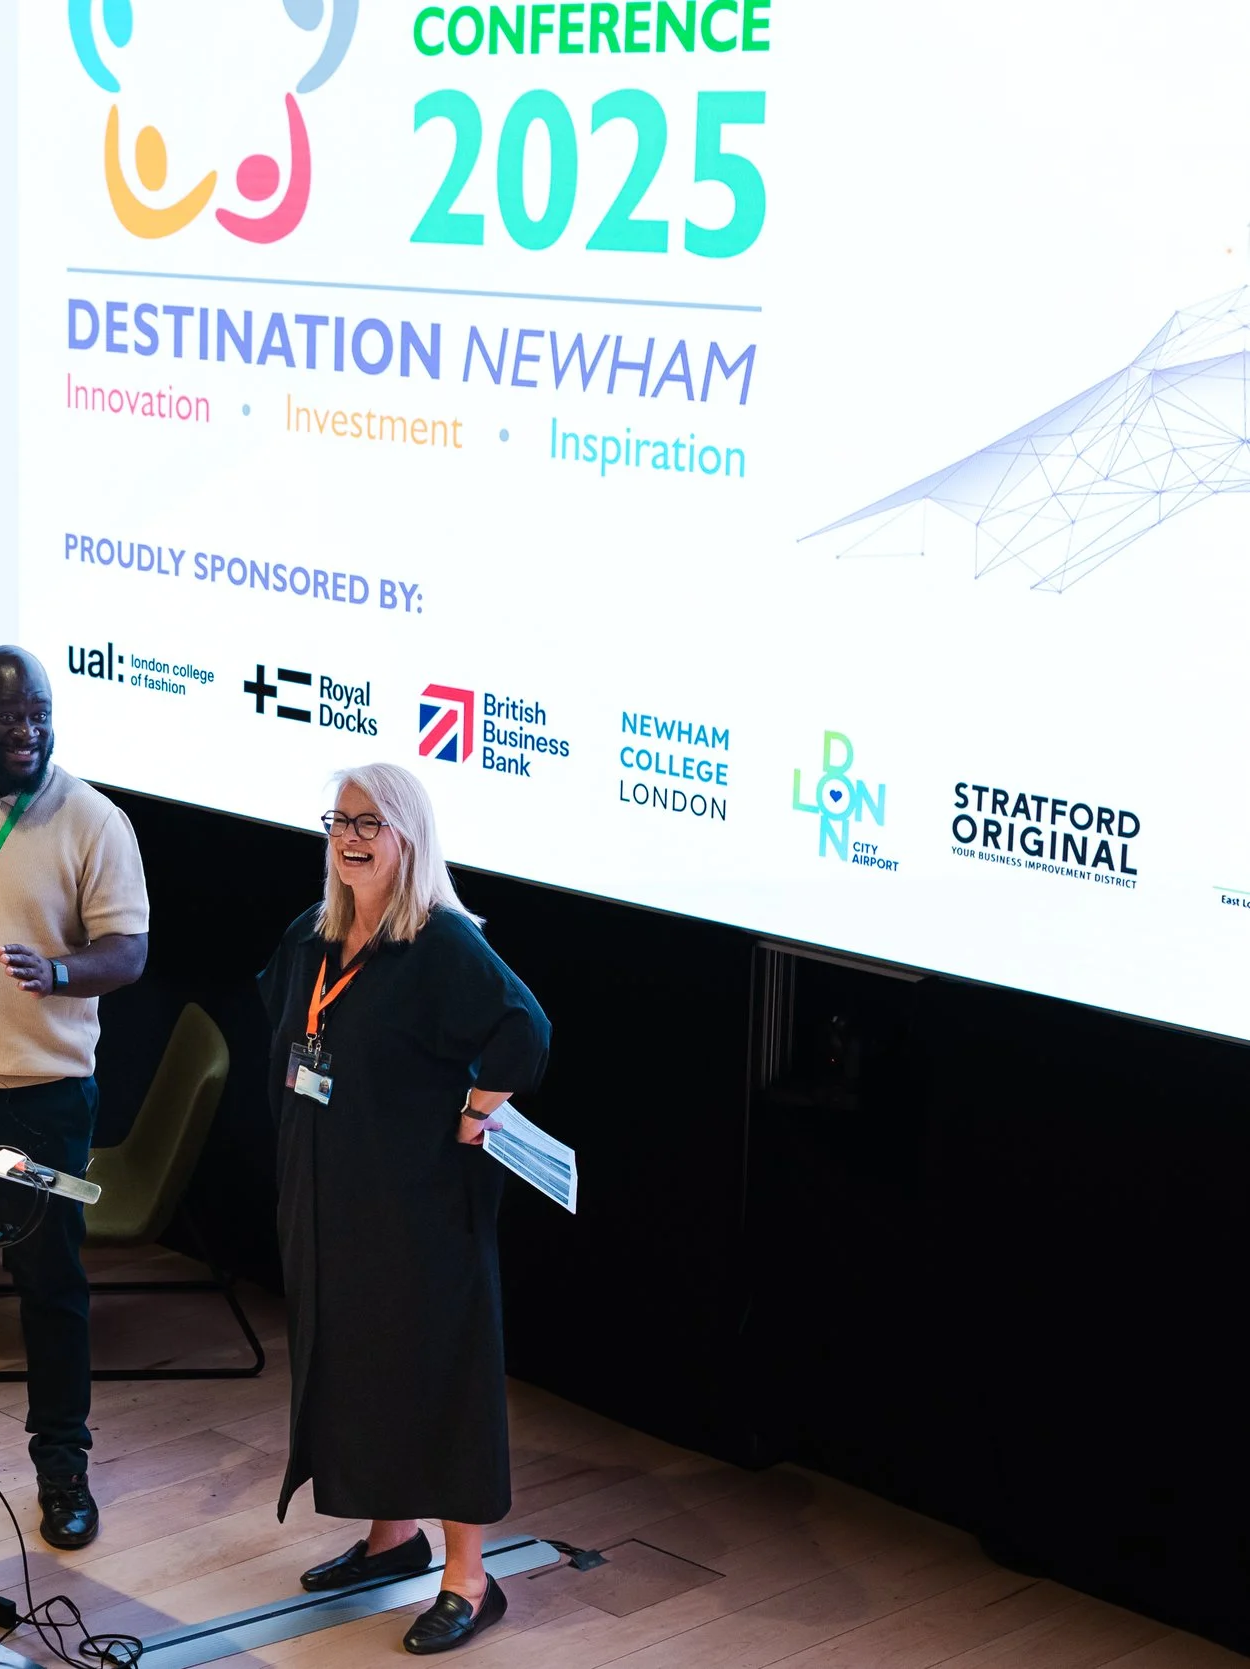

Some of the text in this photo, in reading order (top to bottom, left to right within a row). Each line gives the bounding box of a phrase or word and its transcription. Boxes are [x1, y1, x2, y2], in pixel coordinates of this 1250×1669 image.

[414, 0, 771, 56] CONFERENCE
[410, 88, 766, 259] 2025
[68, 299, 756, 405] DESTINATION NEWHAM
[68, 373, 745, 477] Innovation Investment Inspiration
[65, 533, 422, 613] PROUDLY SPONSORED BY:
[68, 642, 125, 682] ual:
[130, 653, 214, 687] london college
[131, 675, 185, 695] of fashion
[320, 675, 370, 711] Royal
[320, 704, 377, 736] Docks
[484, 693, 546, 725] British
[483, 723, 569, 759] Business
[622, 712, 729, 750] NEWHAM
[483, 753, 530, 777] Bank
[620, 746, 728, 786] COLLEGE
[620, 780, 726, 820] LONDON
[954, 782, 1140, 838] STRATFORD
[851, 854, 899, 871] AIRPORT
[852, 842, 879, 856] CITY
[952, 814, 1137, 875] ORIGINAL
[952, 846, 1136, 888] YOUR BUSINESS IMPROVEMENT DISTRICT
[1222, 895, 1239, 906] East
